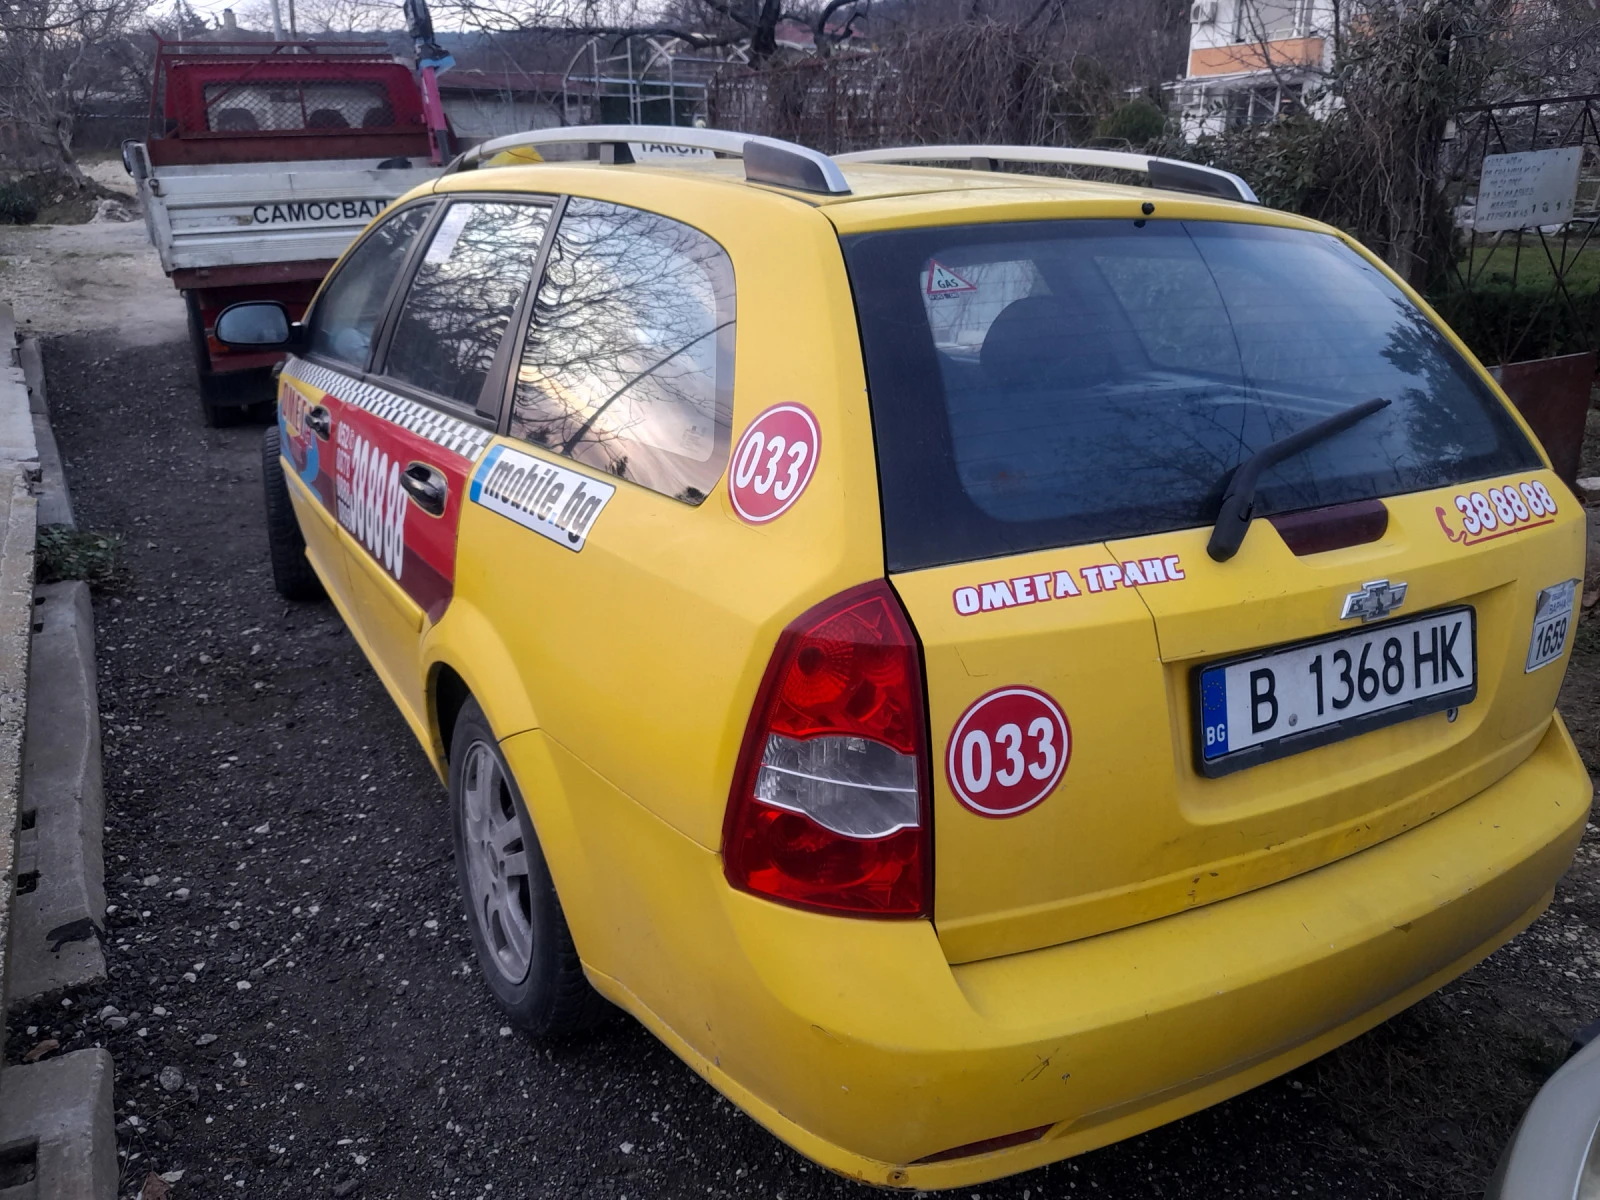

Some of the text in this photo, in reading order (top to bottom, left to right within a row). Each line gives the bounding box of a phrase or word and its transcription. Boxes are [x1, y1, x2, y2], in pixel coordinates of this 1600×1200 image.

[937, 278, 959, 289] GAS
[735, 431, 808, 501] 033
[484, 460, 602, 543] mobile.bg
[953, 554, 1186, 616] ОМЕГА ТРАНС
[1535, 617, 1567, 660] 1659
[1309, 637, 1405, 716] 1368
[962, 716, 1057, 793] 033
[1206, 722, 1227, 746] BG
